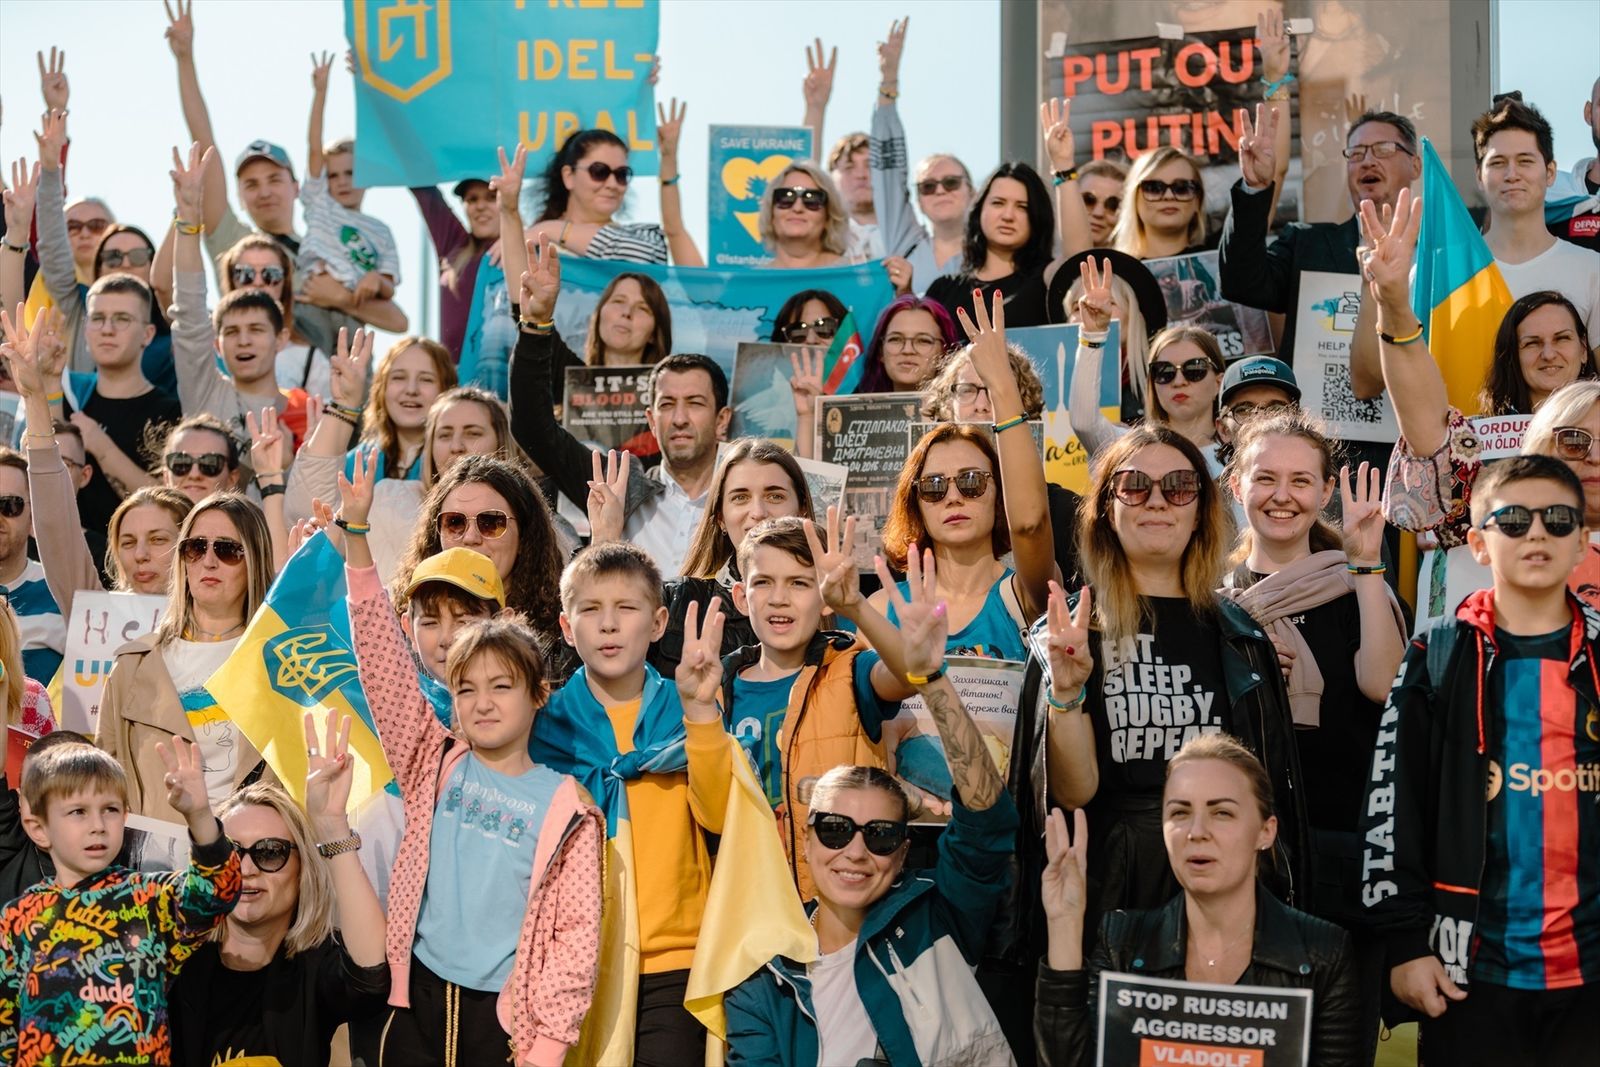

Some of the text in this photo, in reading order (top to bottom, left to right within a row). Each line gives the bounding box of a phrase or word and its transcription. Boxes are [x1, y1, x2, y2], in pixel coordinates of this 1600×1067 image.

[517, 40, 653, 80] IDEL-
[1063, 47, 1161, 98] PUT
[720, 137, 805, 151] SAVE UKRAINE
[1092, 108, 1244, 160] PUTIN
[1318, 341, 1347, 351] HELP
[847, 419, 913, 435] СТОЛПАКОВ
[1102, 633, 1163, 668] EAT.
[952, 675, 1009, 687] Захисникам
[1103, 662, 1203, 696] SLEEP.
[958, 688, 1003, 700] вітанок!
[965, 703, 999, 716] береже
[1104, 691, 1222, 730] RUGBY.
[1110, 725, 1222, 764] REPE
[79, 977, 135, 1004] dude
[1116, 988, 1288, 1020] STOP RUSSIAN
[1131, 1017, 1277, 1046] AGGRESSOR
[1152, 1045, 1252, 1067] VLADOLF
